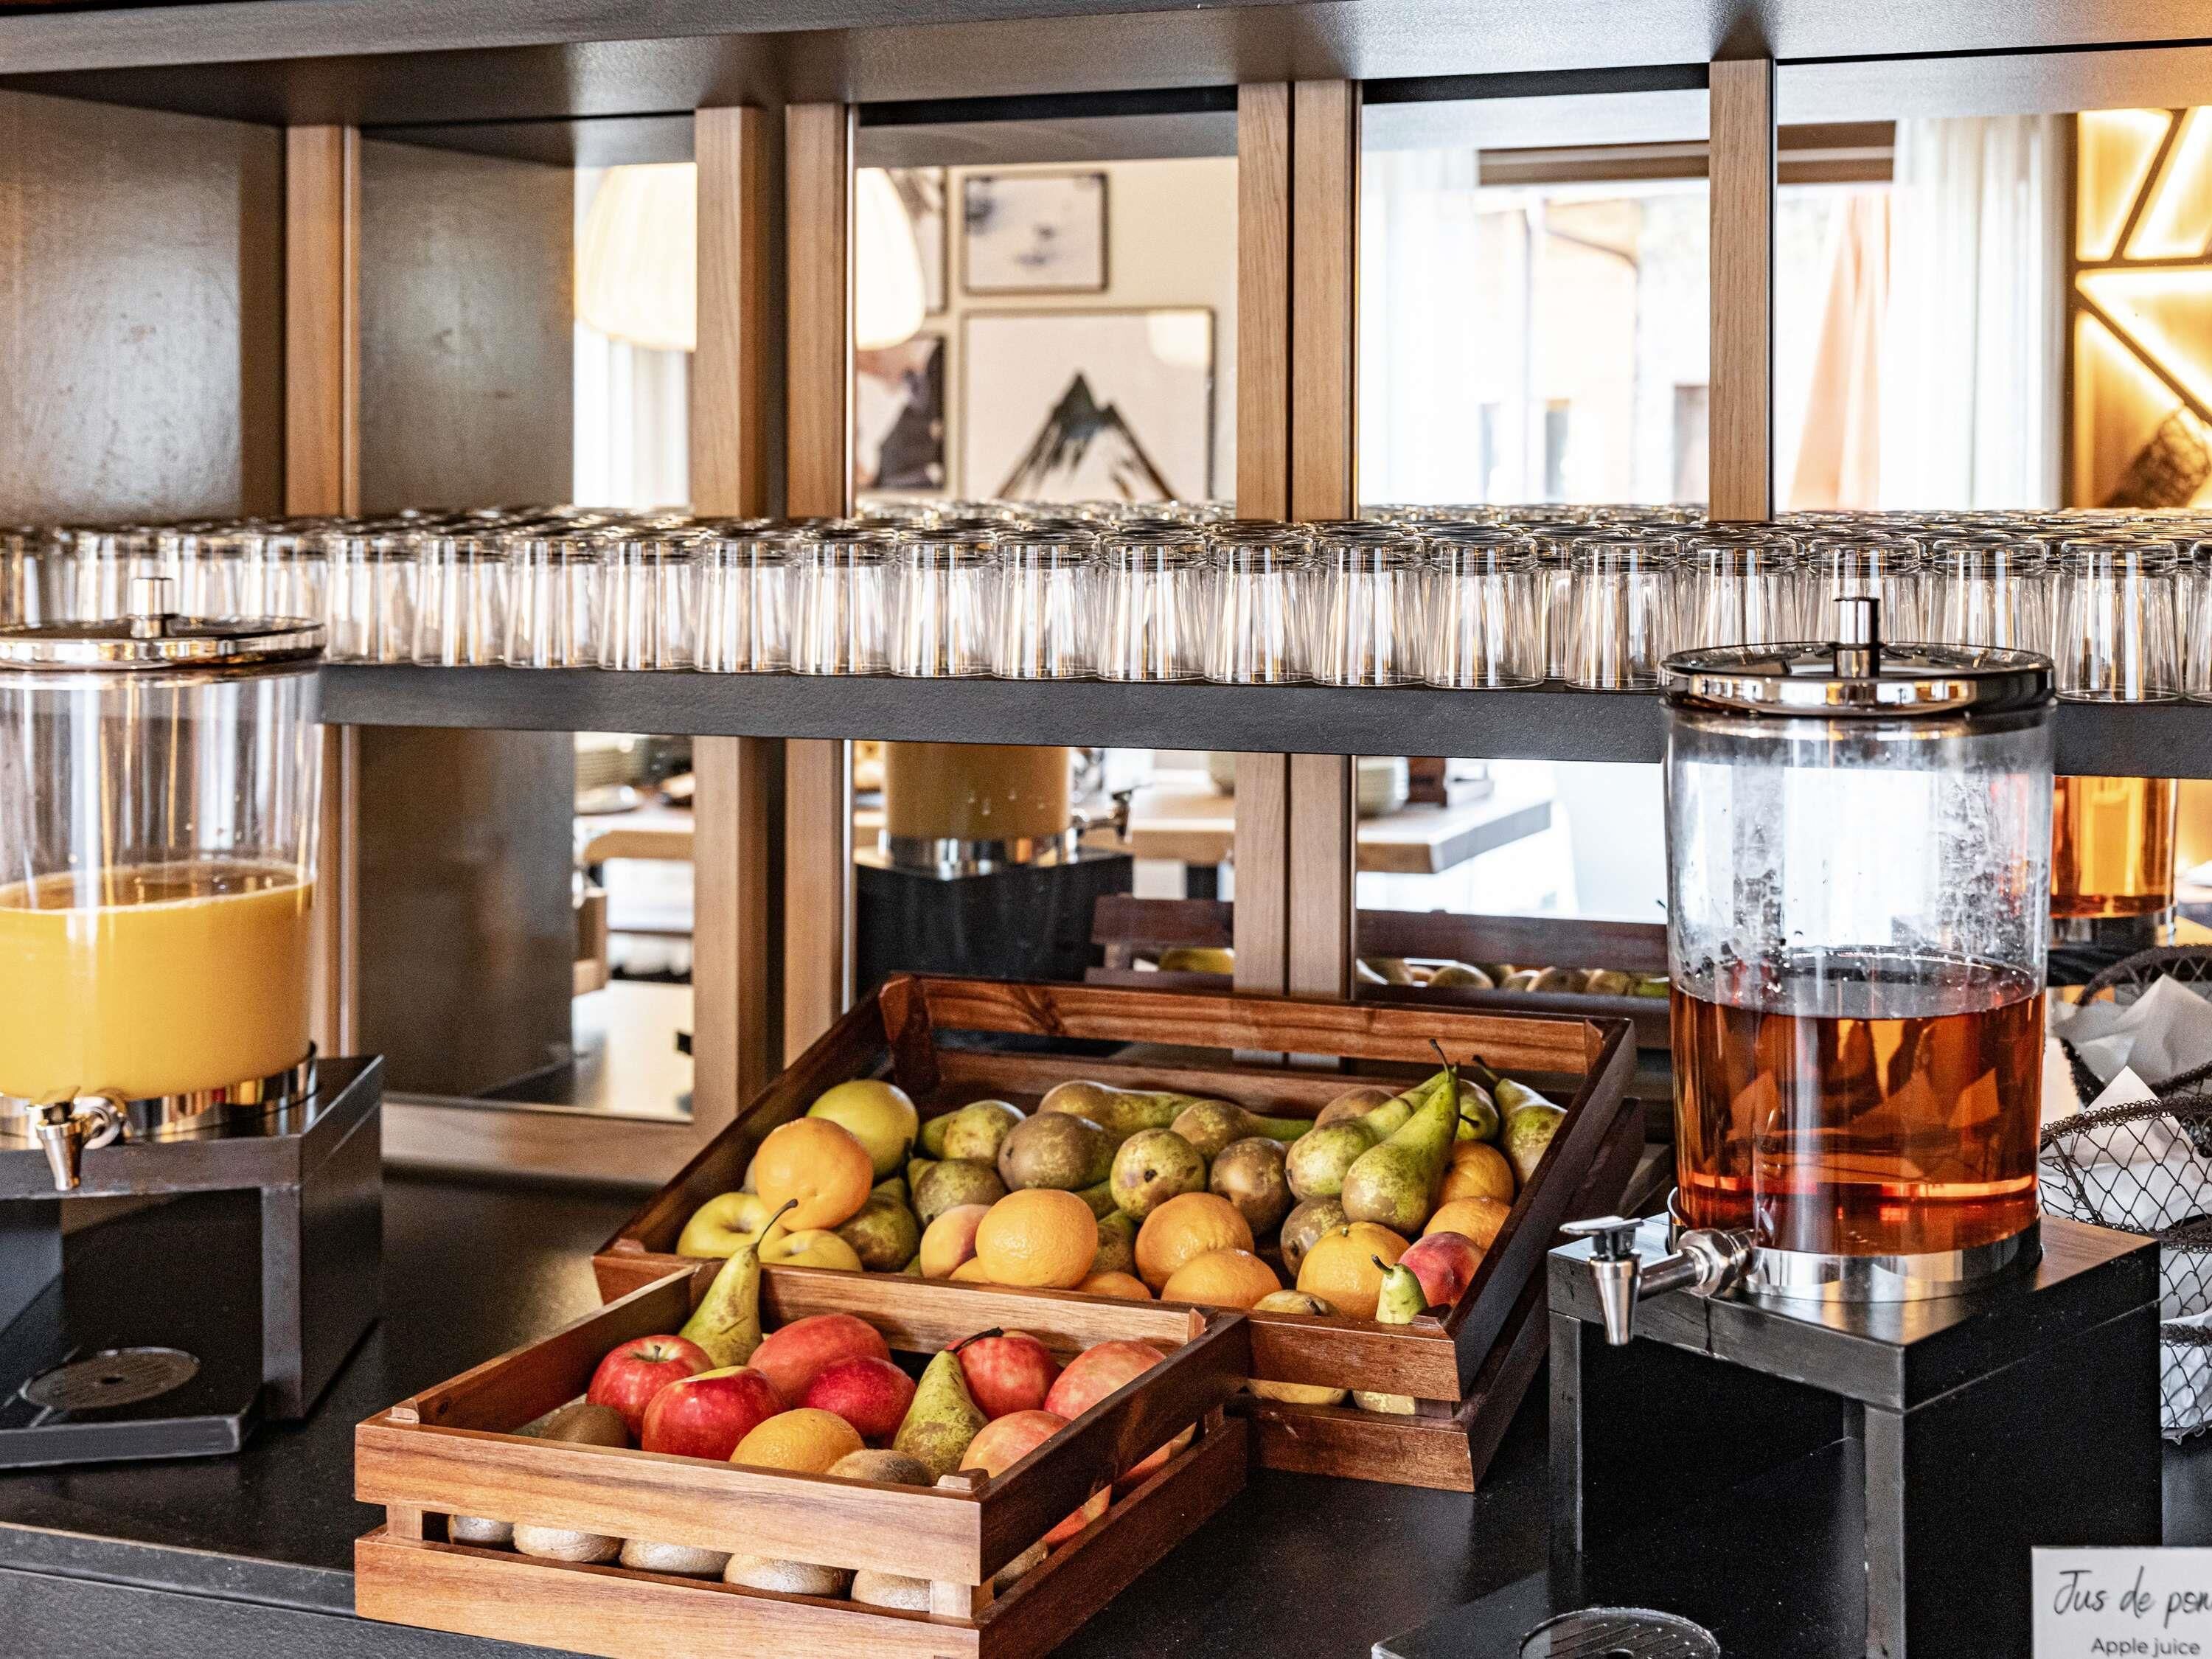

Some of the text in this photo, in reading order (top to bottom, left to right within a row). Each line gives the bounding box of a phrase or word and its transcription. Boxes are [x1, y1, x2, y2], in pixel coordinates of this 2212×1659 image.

[2053, 1569, 2108, 1615] Jus
[2118, 1565, 2154, 1618] de
[2091, 1637, 2201, 1658] Apple juice
